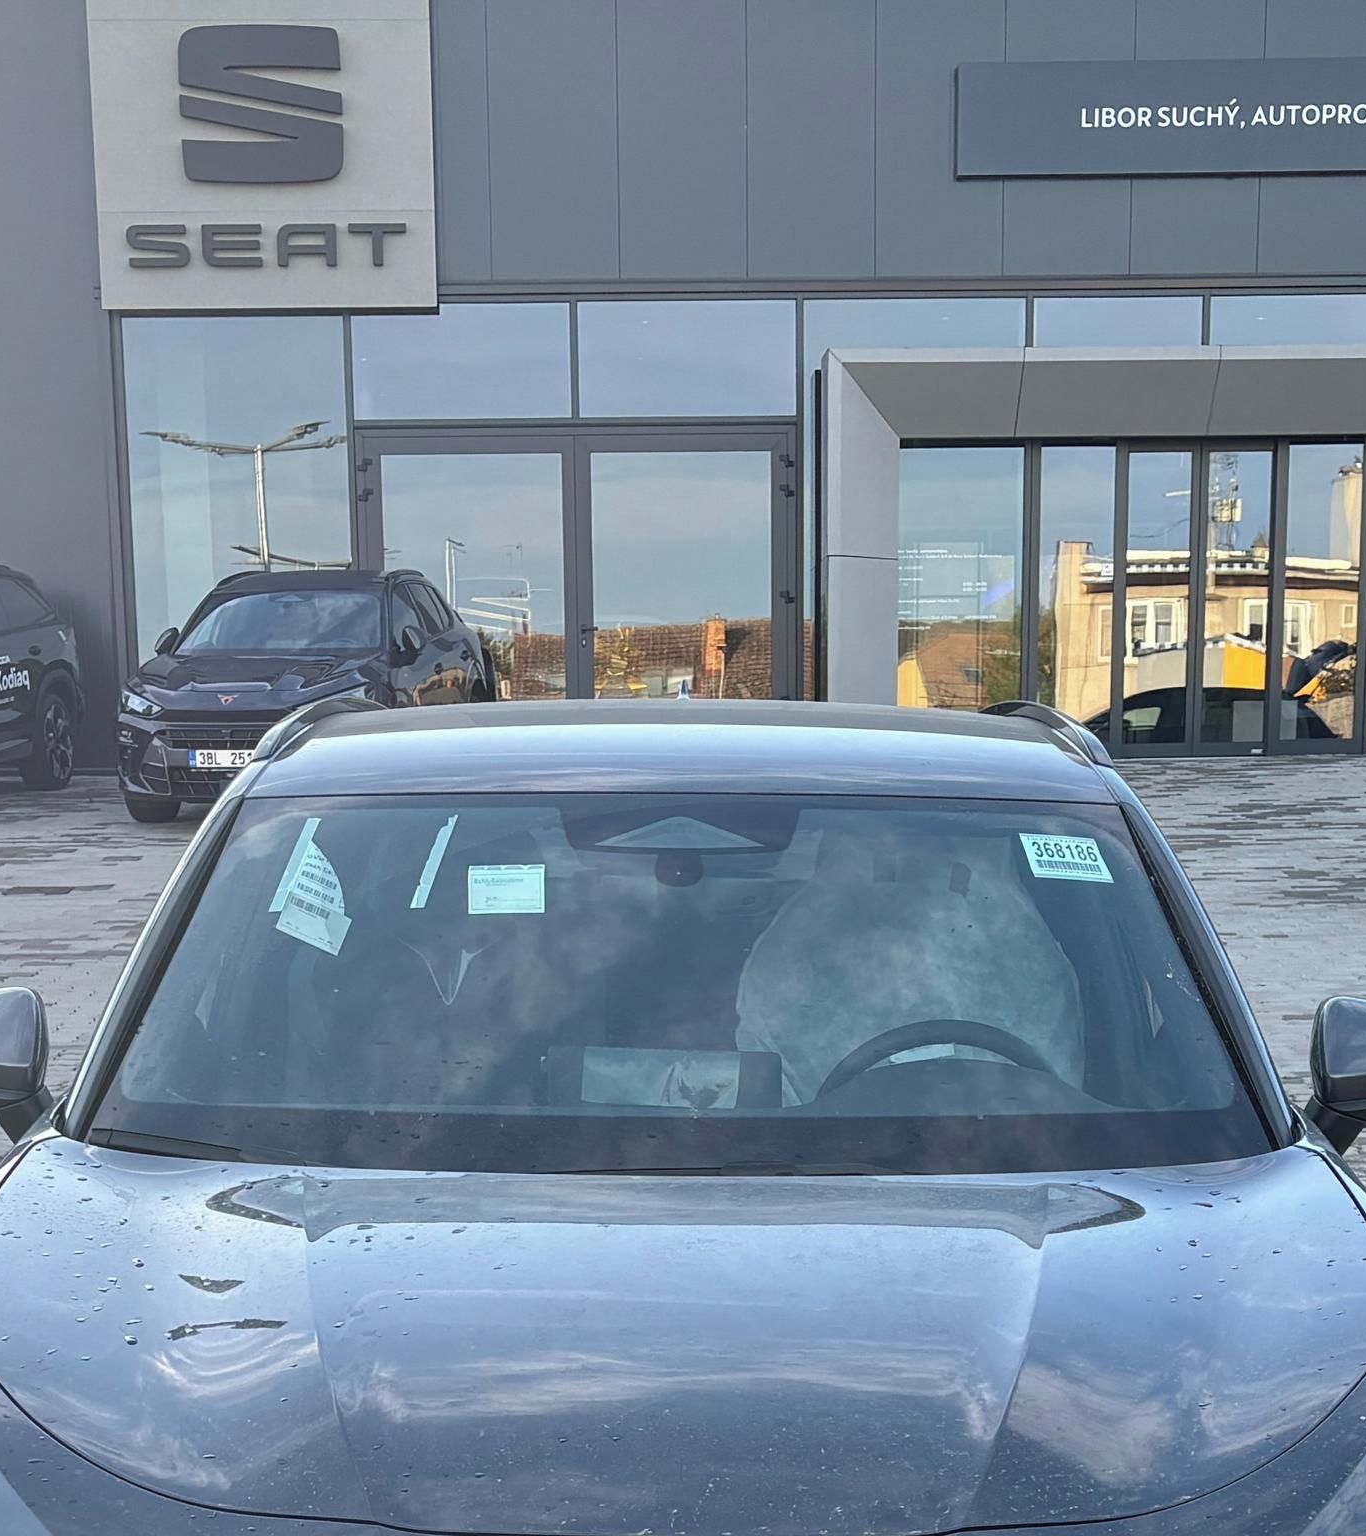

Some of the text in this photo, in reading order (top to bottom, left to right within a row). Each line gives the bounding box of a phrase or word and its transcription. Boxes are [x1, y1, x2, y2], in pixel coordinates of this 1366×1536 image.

[1081, 106, 1151, 128] LIBOR
[1157, 98, 1246, 129] SUCHÝ,
[125, 222, 407, 268] SEAT
[199, 752, 221, 765] 3BL
[1032, 841, 1098, 862] 368186
